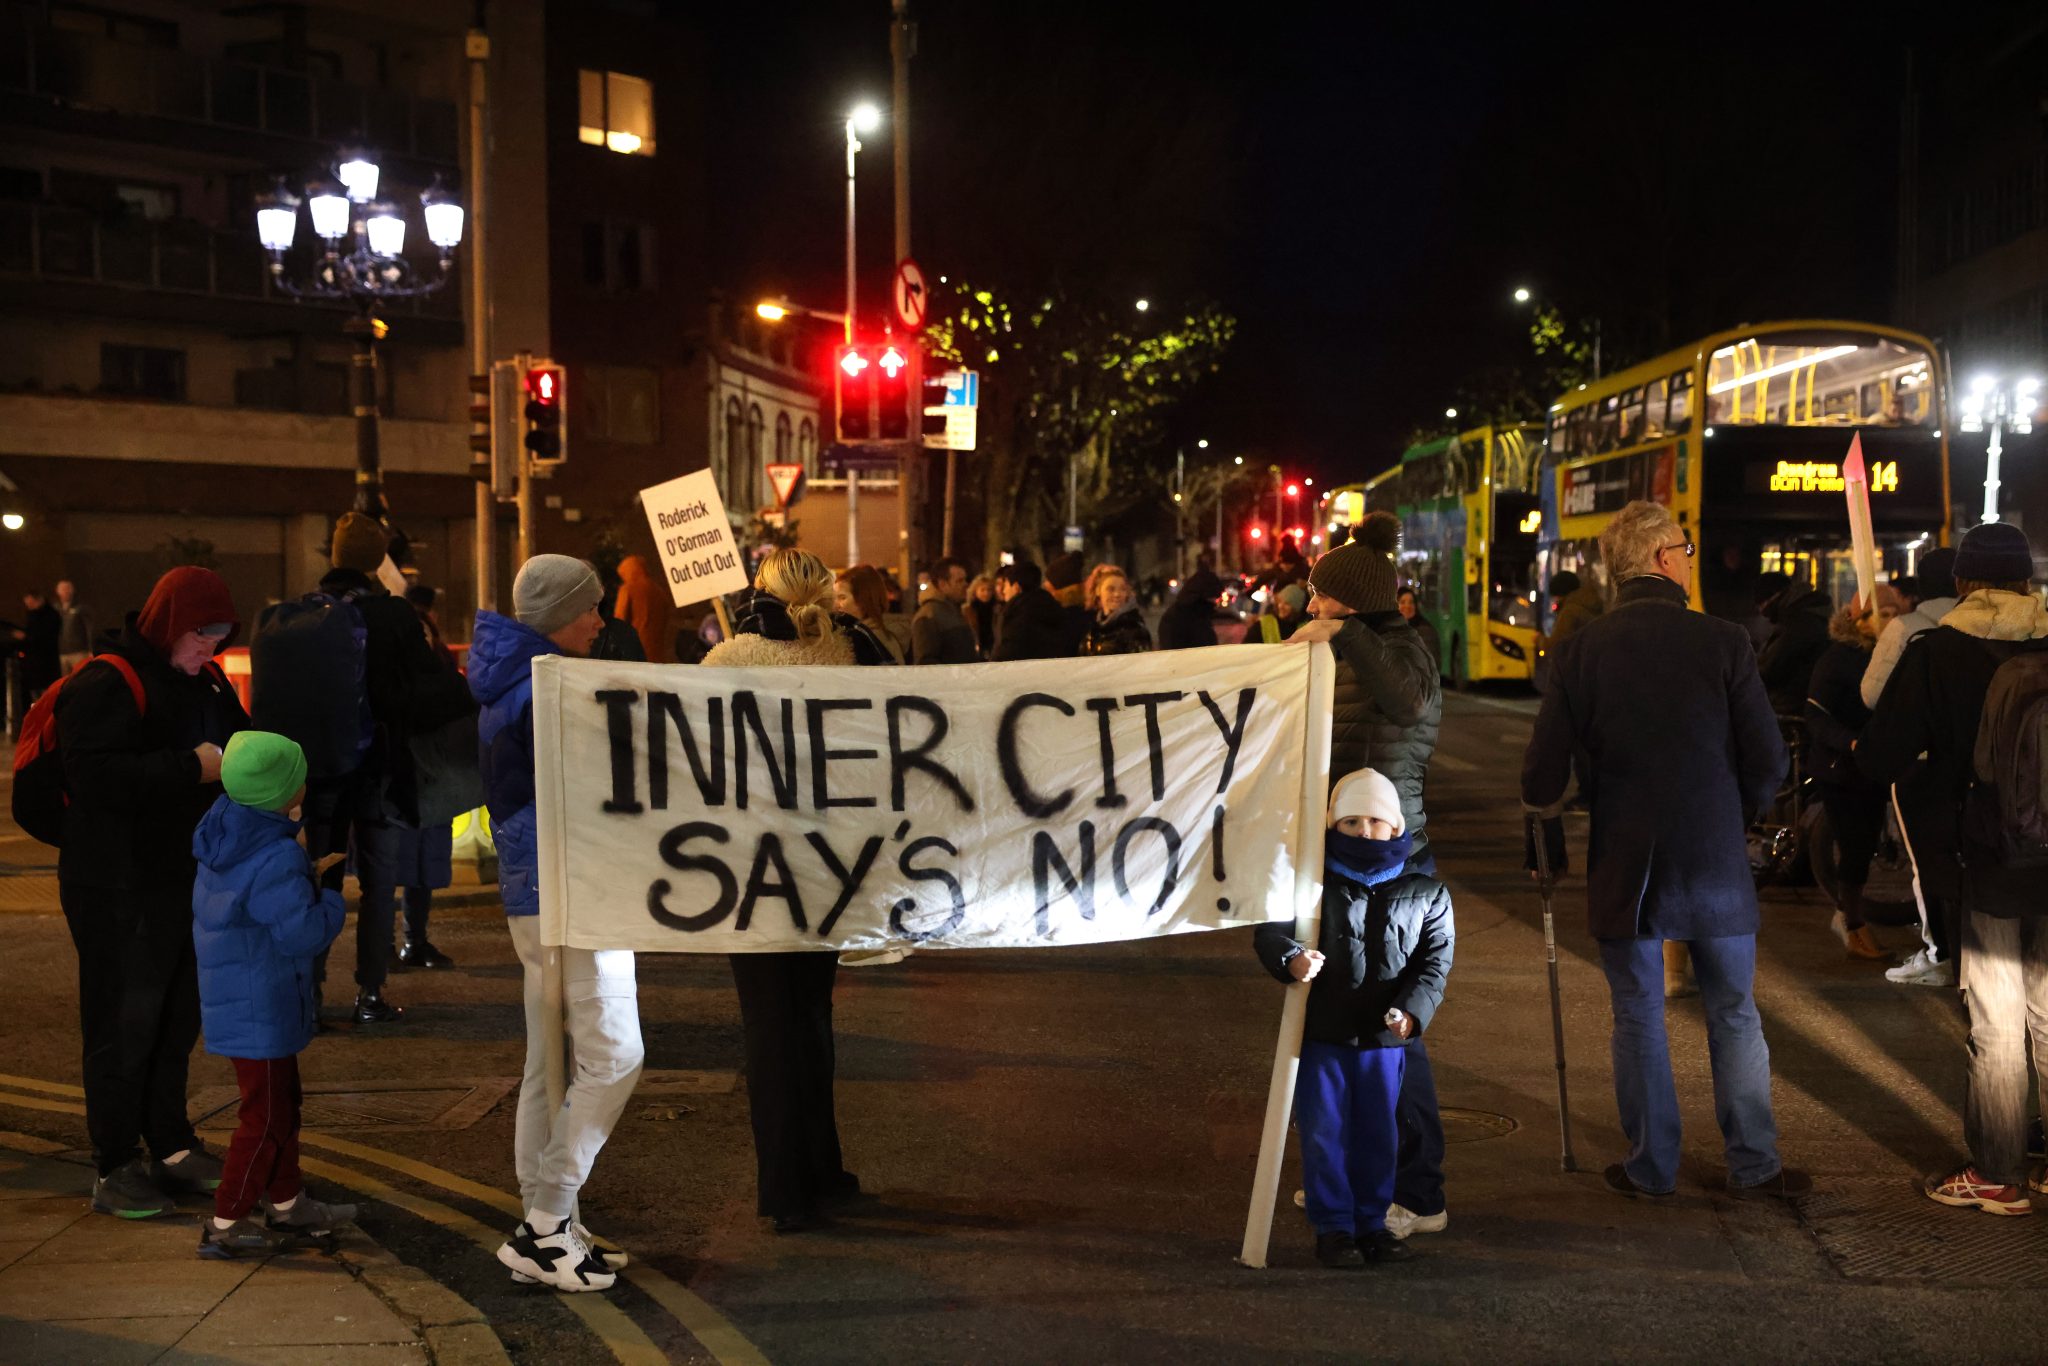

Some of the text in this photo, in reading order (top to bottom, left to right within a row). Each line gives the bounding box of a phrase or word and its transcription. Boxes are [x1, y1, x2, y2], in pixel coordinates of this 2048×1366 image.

[1871, 461, 1898, 491] 14
[658, 500, 709, 530] Roderick
[665, 528, 722, 556] O'Gorman
[670, 551, 736, 584] Out Out Out
[595, 688, 1257, 818] INNER CITY
[646, 804, 1230, 940] SAY'S NO!
